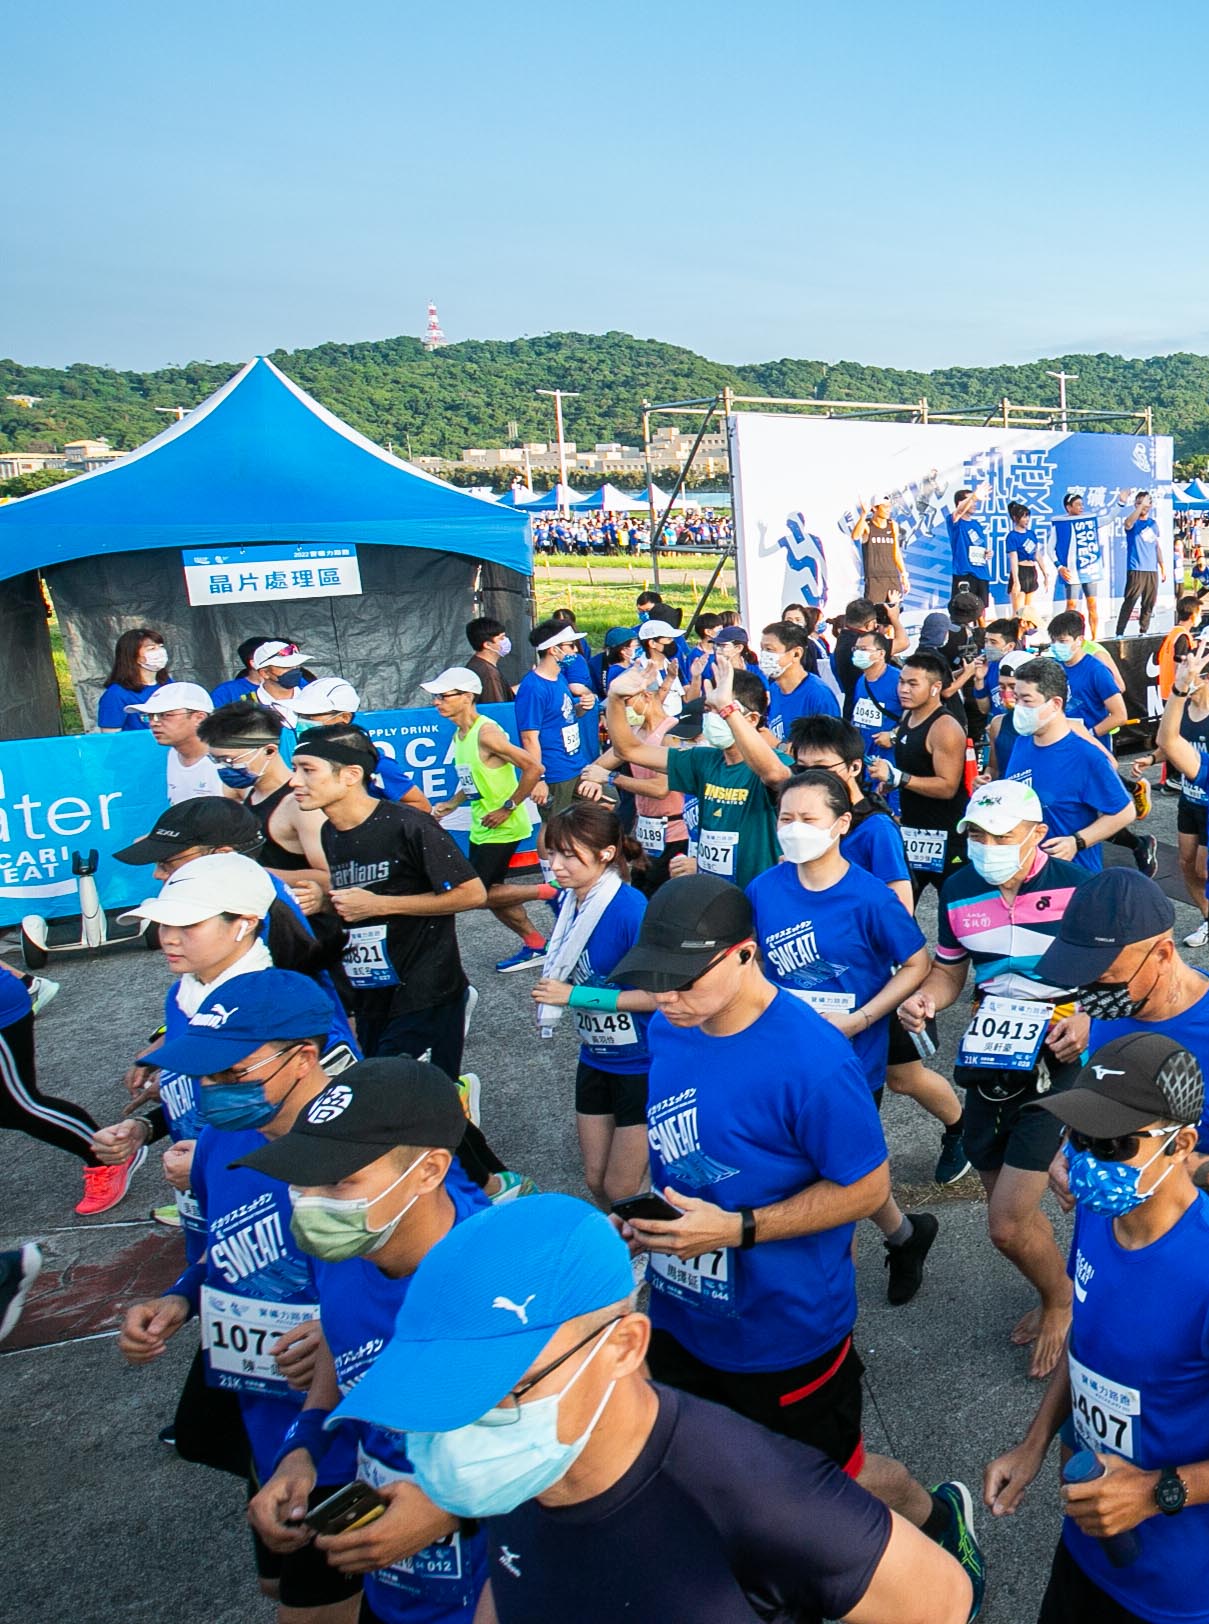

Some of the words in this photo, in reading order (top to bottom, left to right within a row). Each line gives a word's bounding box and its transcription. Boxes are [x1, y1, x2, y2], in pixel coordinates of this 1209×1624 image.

[209, 567, 341, 594] 晶片處理區
[856, 707, 881, 719] 10453
[401, 724, 439, 735] DRINK
[904, 840, 942, 854] 10772
[767, 931, 820, 976] SWEAT!
[577, 1012, 631, 1034] 20148
[968, 1016, 1040, 1041] 10413
[964, 1055, 978, 1064] 21K
[648, 1106, 701, 1165] SWEAT!
[211, 1211, 288, 1285] SWEAT!
[427, 1560, 452, 1573] 012
